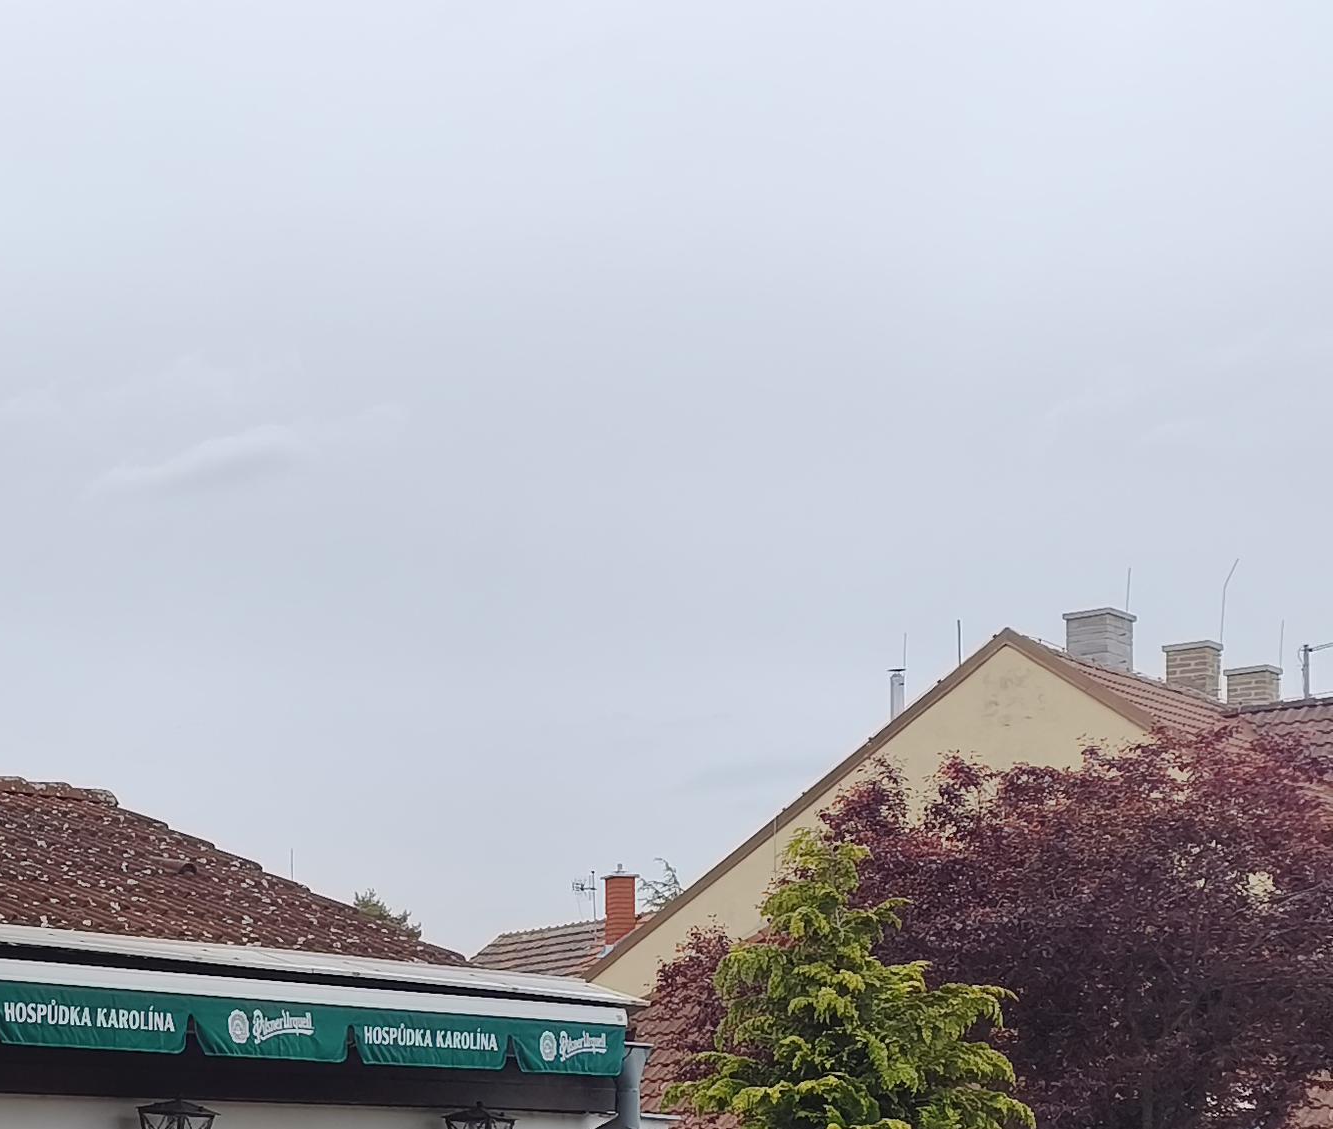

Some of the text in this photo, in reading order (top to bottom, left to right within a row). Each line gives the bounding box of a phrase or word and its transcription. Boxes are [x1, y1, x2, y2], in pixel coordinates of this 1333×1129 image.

[3, 999, 176, 1033] HOSPŮDKA KAROLÍNA
[252, 1009, 284, 1044] Pilsner
[363, 1023, 499, 1051] HOSPŮDKA KAROLÍNA
